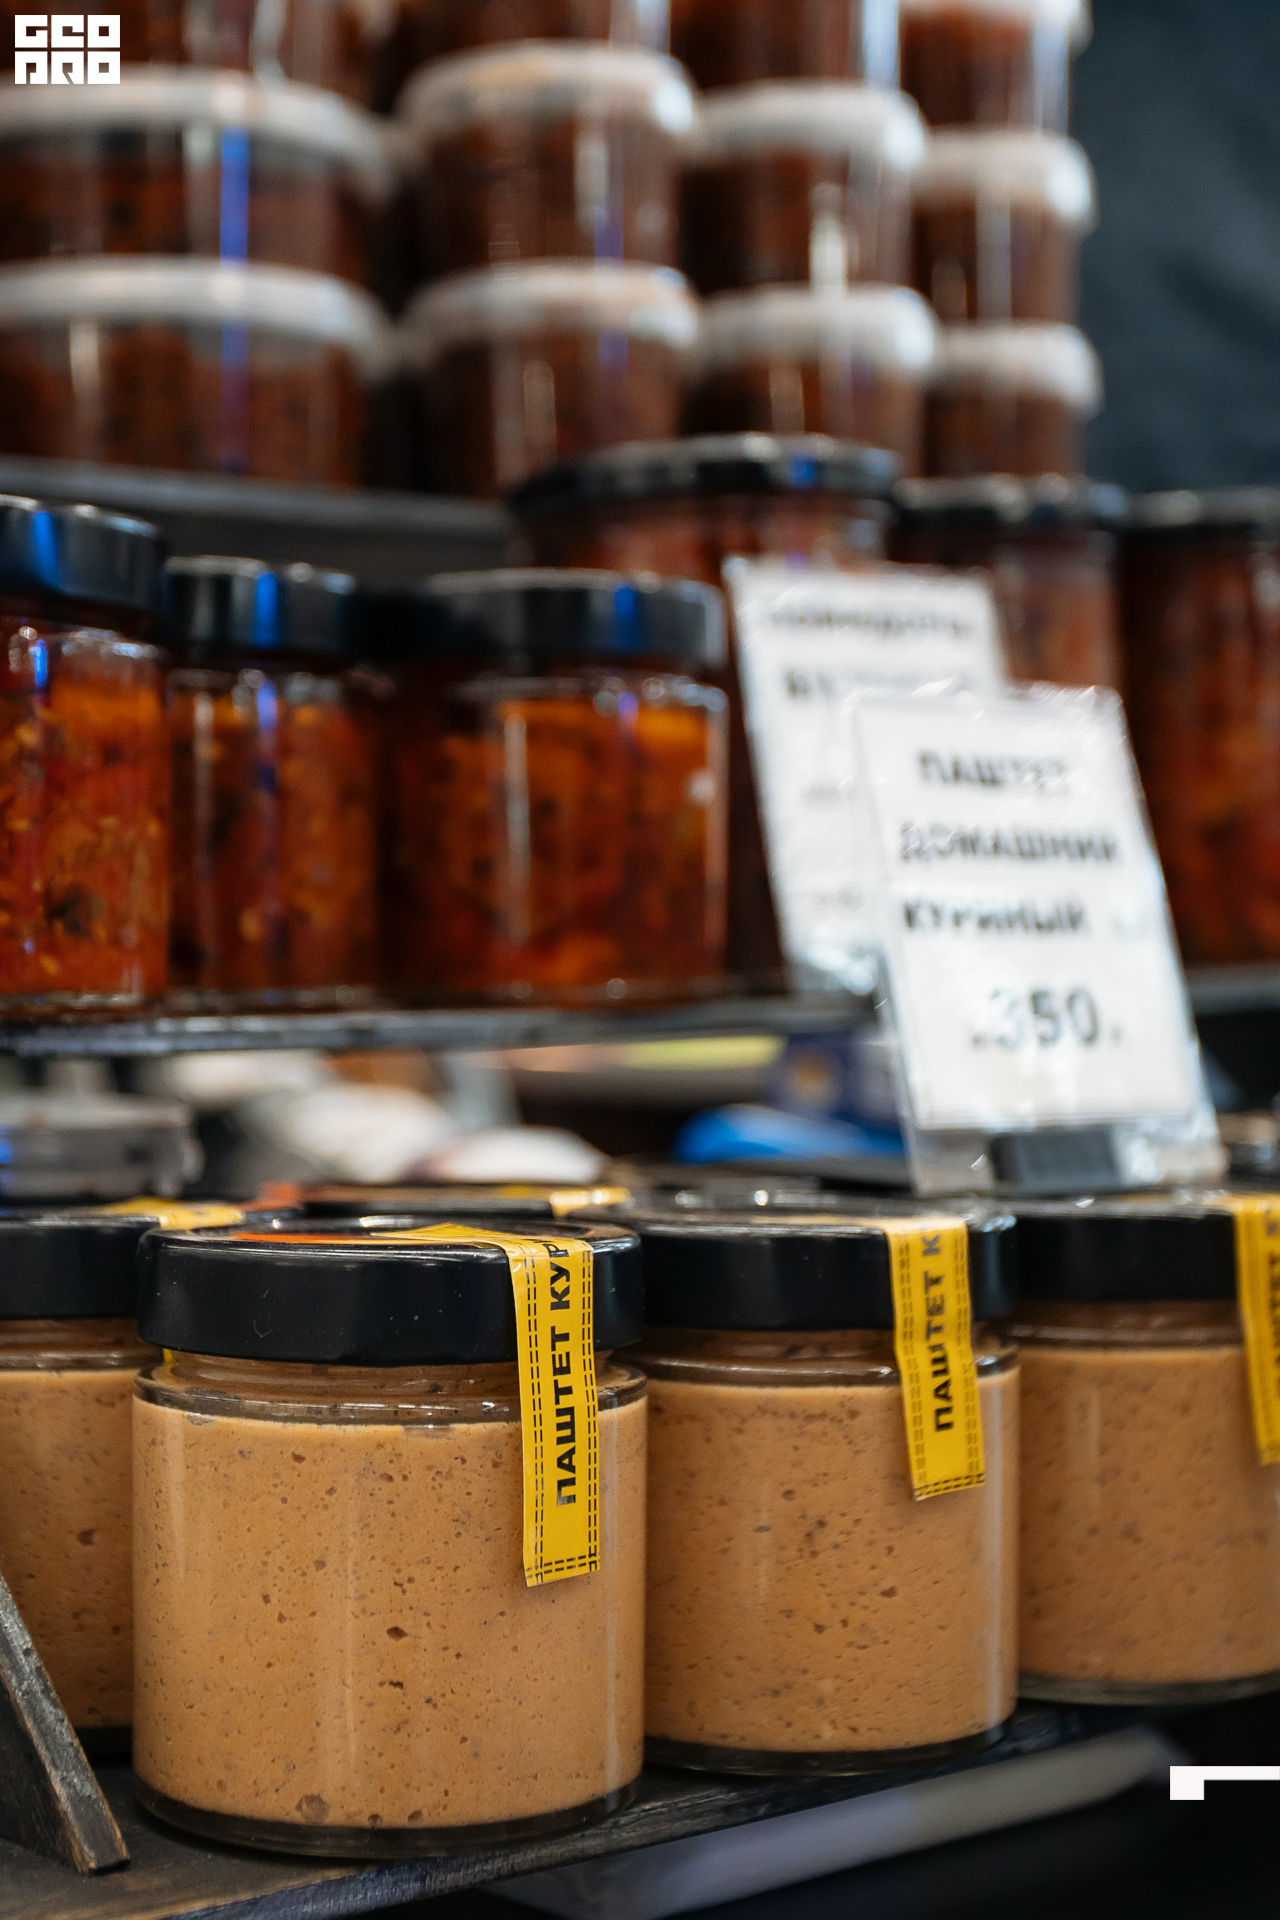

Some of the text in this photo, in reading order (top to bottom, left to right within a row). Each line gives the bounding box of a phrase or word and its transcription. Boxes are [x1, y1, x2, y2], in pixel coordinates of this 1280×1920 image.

[538, 1239, 577, 1506] ПАШТЕТ КУР
[923, 1270, 954, 1433] ПАШТЕТ
